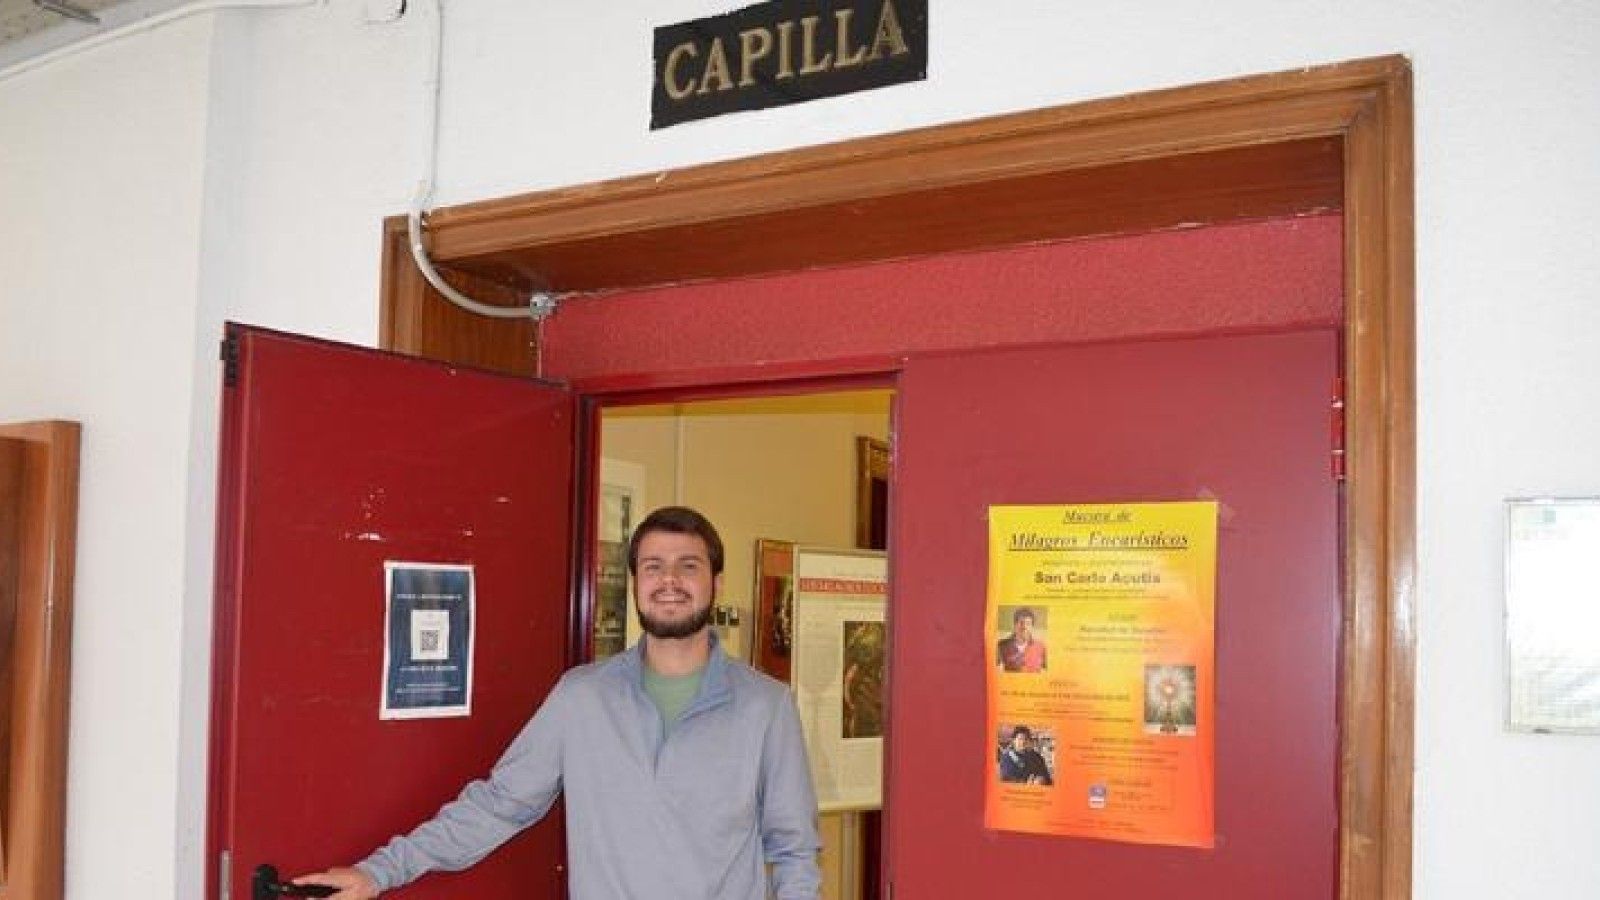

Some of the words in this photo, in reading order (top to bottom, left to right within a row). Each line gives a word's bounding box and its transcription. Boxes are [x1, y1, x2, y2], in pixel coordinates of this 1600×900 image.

[664, 0, 908, 99] CAPILLA
[1115, 510, 1132, 523] de
[1009, 532, 1078, 550] Milagros
[1034, 571, 1062, 584] San
[1067, 571, 1106, 584] Carlo
[1111, 571, 1161, 584] Acutis
